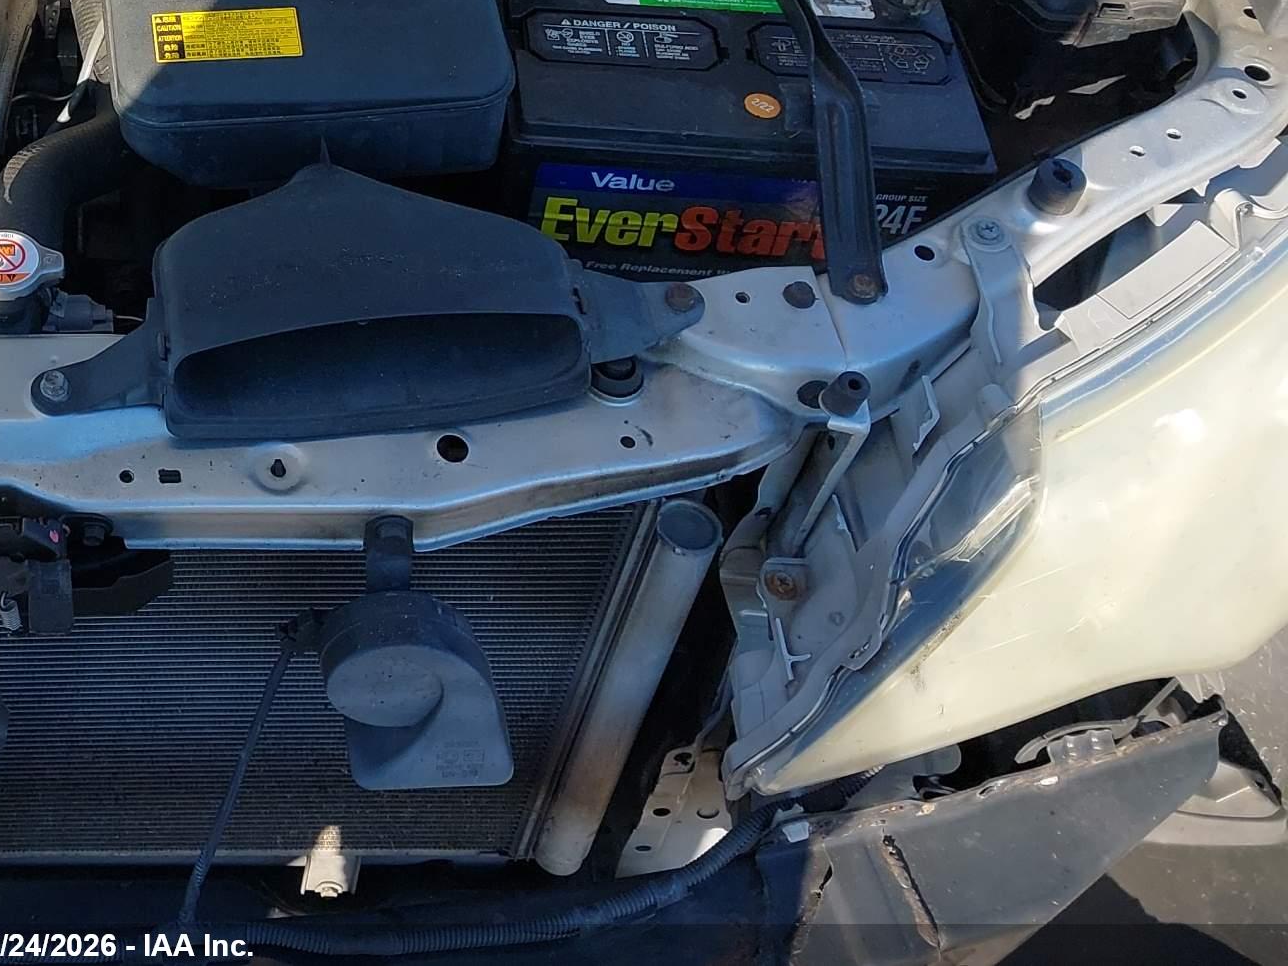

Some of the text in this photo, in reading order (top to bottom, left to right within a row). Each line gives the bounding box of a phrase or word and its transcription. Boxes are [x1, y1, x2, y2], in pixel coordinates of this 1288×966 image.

[573, 19, 621, 28] DANGER
[632, 22, 677, 31] POISON
[591, 171, 675, 192] Value
[875, 193, 907, 202] GROUP
[585, 261, 617, 270] Free
[621, 263, 712, 276] Replacement
